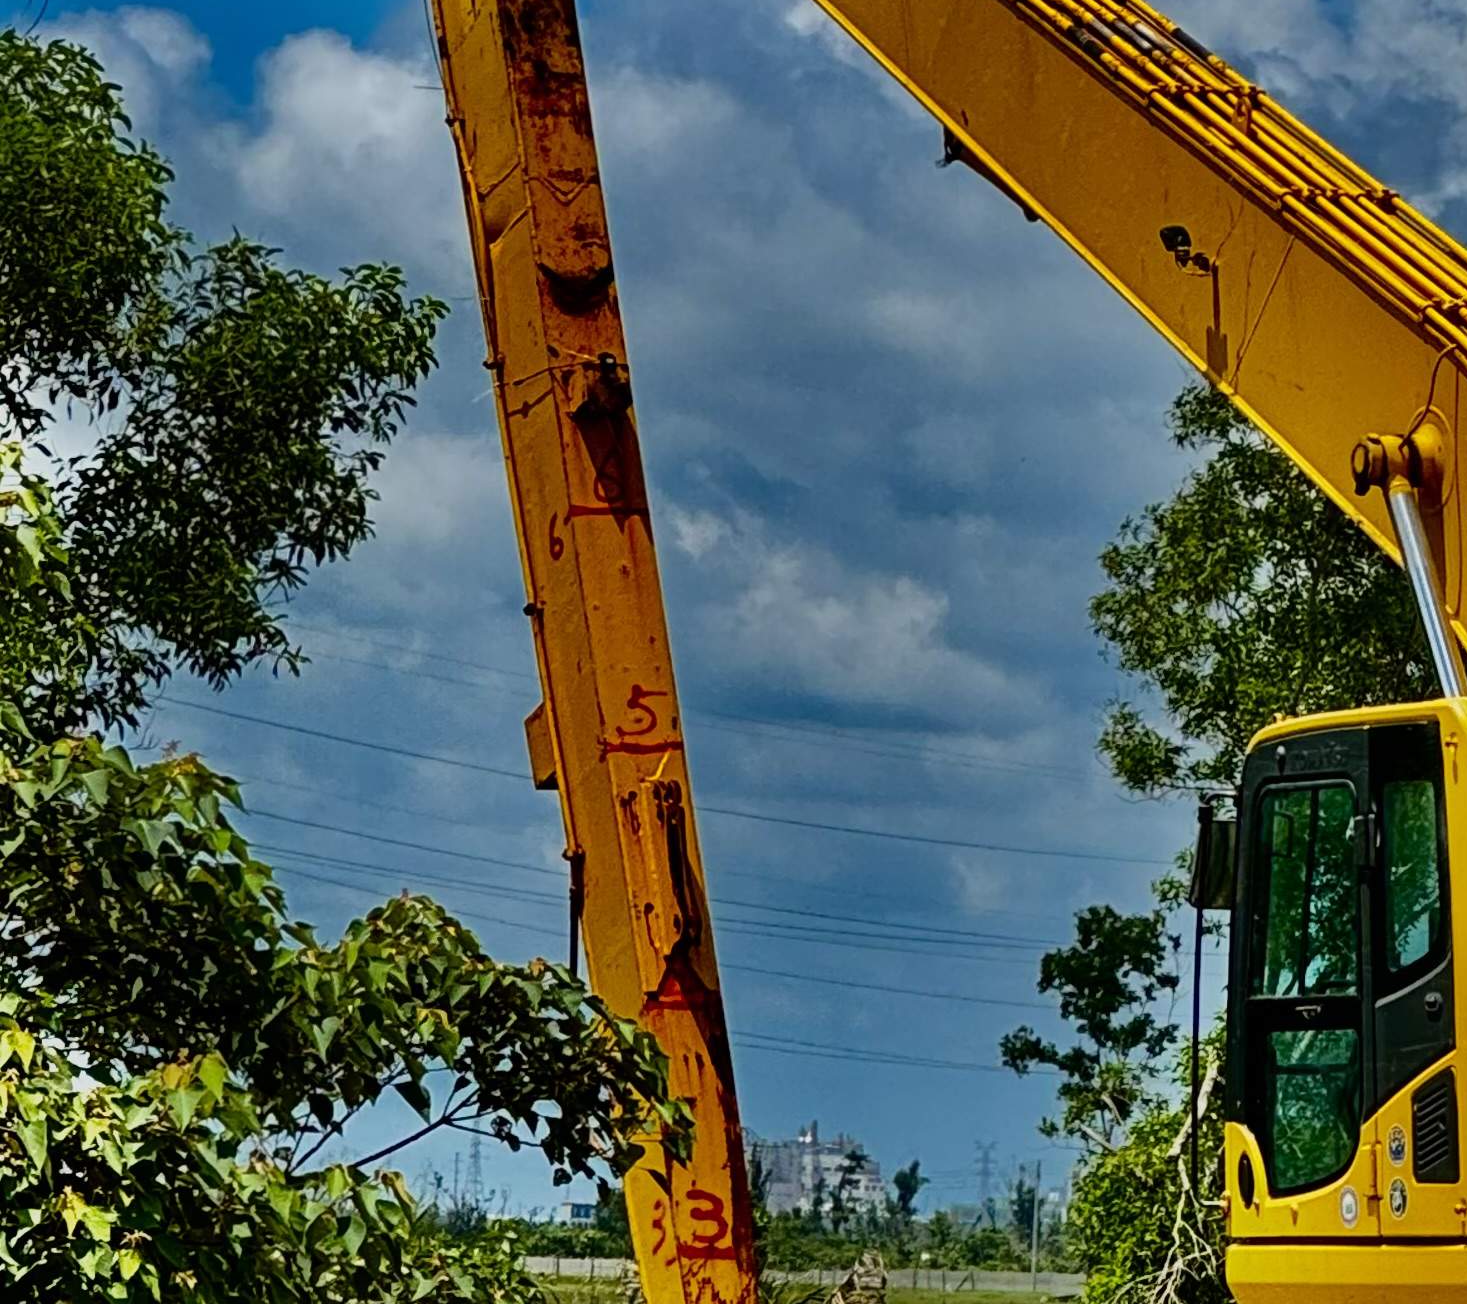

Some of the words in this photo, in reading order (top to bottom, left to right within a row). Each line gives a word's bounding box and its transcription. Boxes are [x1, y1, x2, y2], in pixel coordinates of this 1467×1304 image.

[549, 511, 564, 561] 6
[616, 684, 668, 736] 5
[686, 1188, 729, 1244] 3
